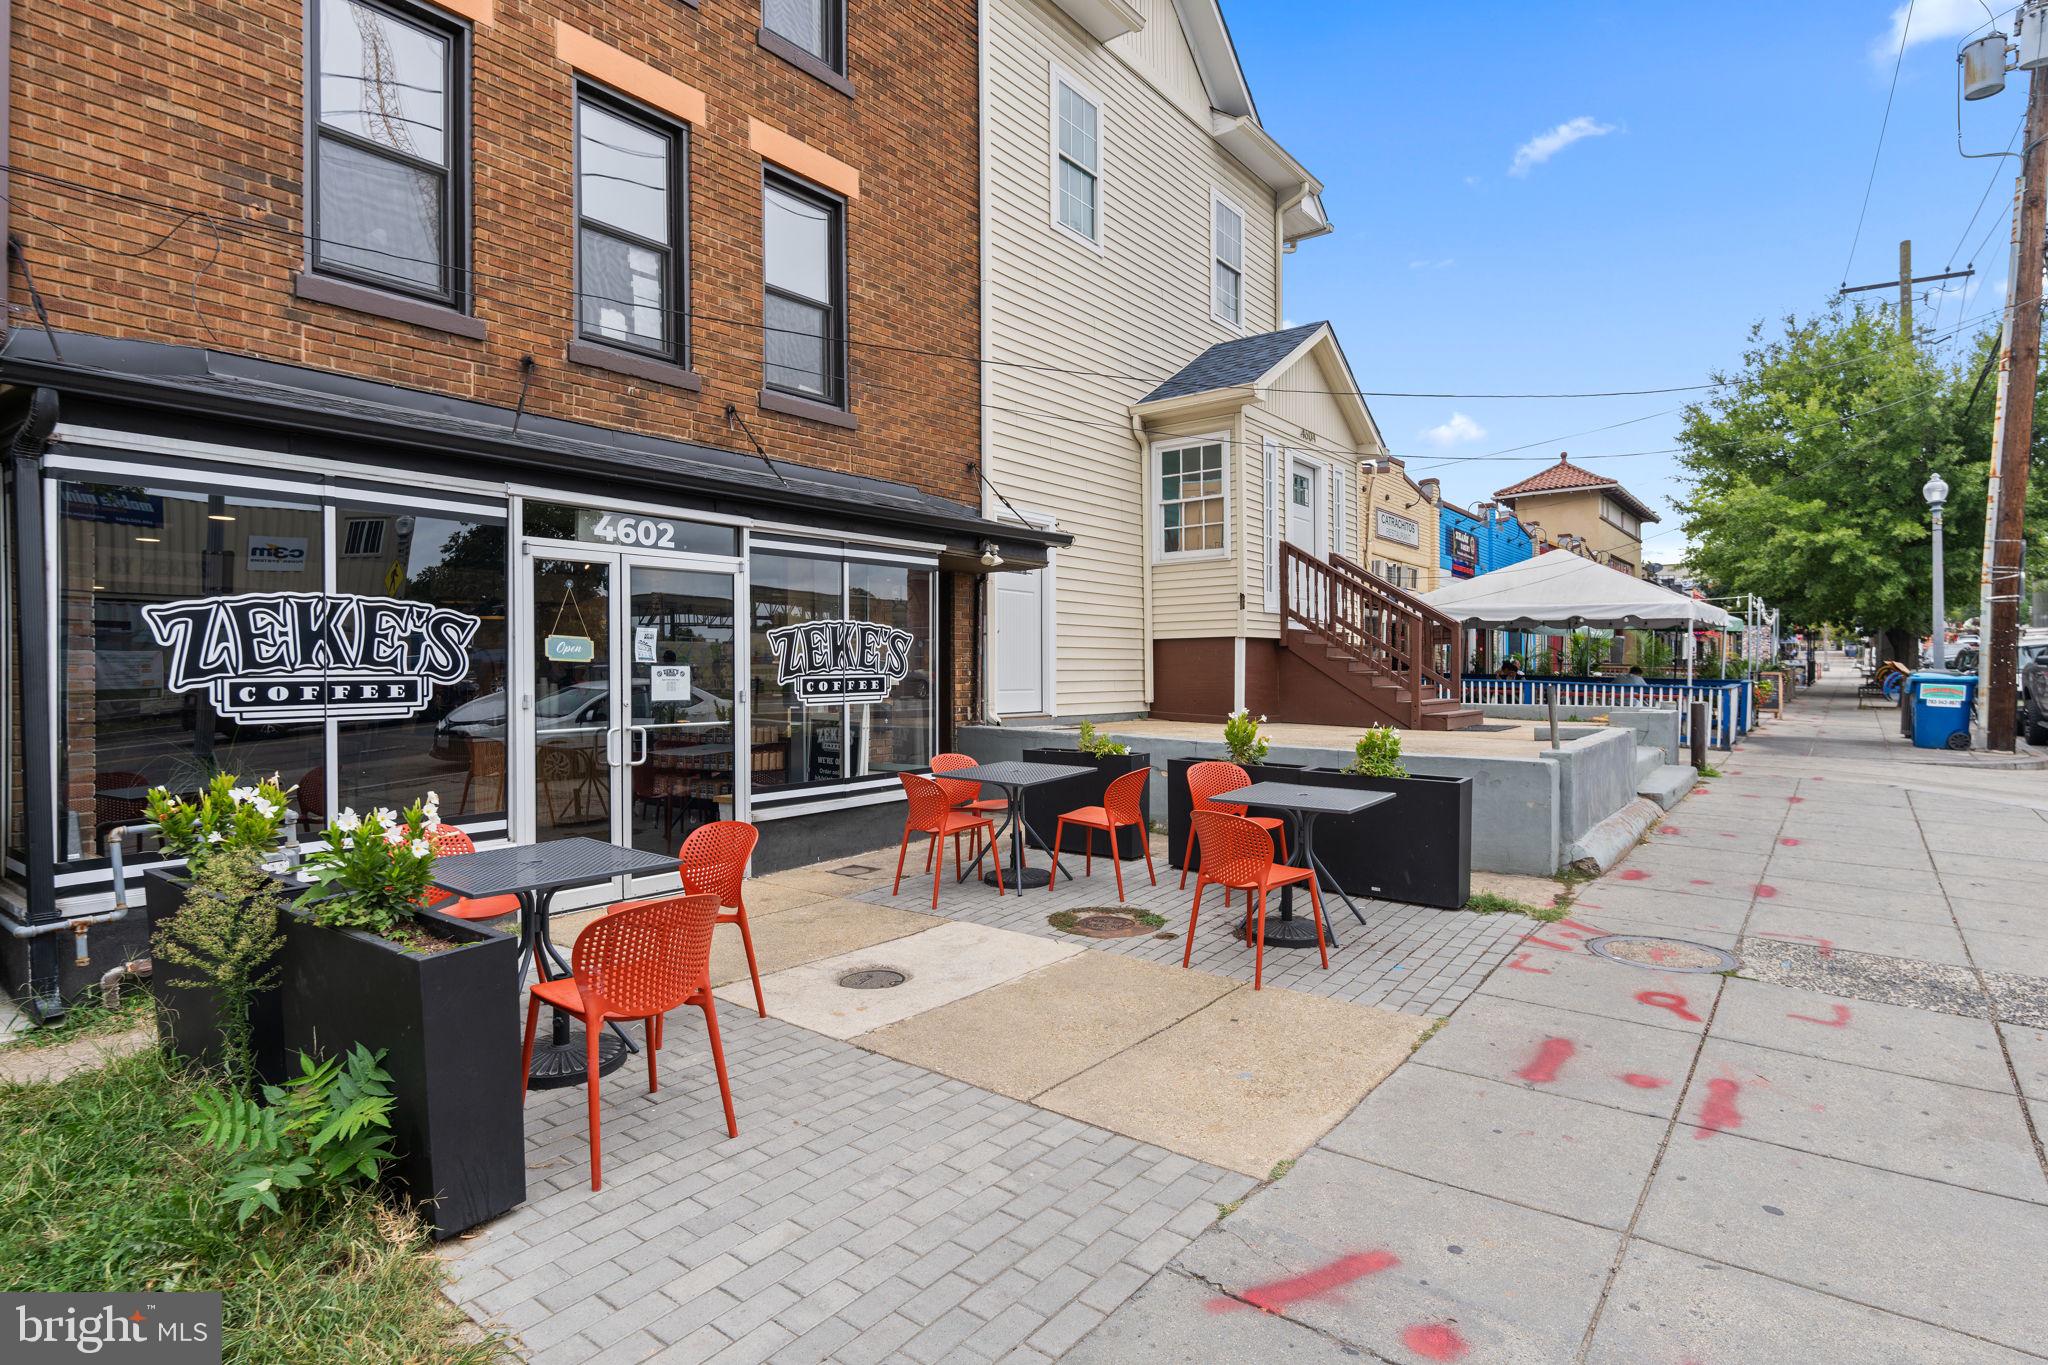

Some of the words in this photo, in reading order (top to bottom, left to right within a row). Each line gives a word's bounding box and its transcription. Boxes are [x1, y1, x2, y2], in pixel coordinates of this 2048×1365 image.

[593, 514, 676, 549] 4602
[1380, 513, 1416, 534] CATRACHITOS
[141, 591, 482, 694] ZEKE'S
[556, 640, 583, 656] Open
[766, 619, 914, 686] ZEKE'S
[237, 683, 409, 703] COFFEE
[806, 678, 881, 693] COFFEE
